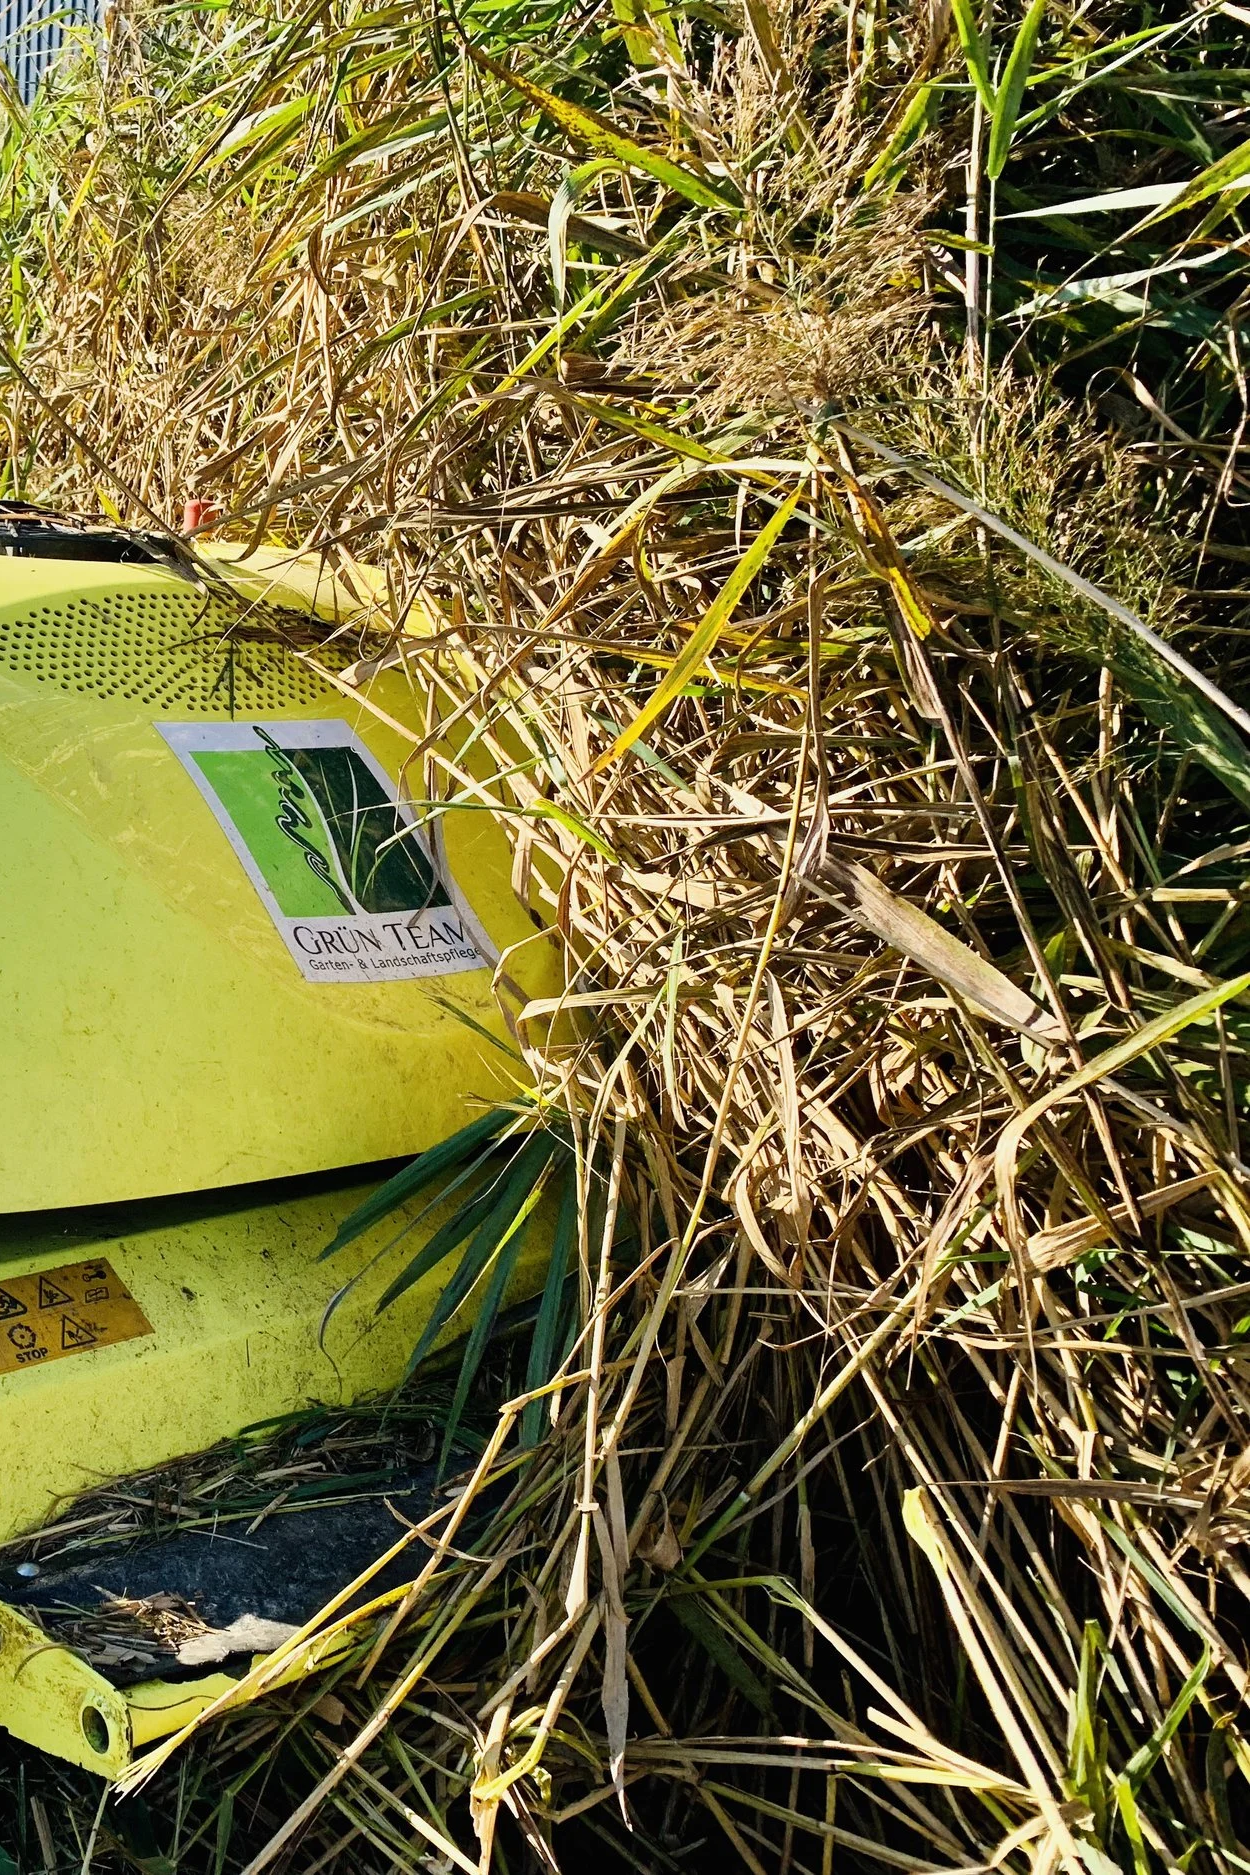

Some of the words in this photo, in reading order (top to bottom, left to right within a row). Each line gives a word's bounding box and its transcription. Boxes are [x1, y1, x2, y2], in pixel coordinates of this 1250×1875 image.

[309, 959, 354, 971] Garten-
[359, 958, 369, 970] &
[16, 1347, 49, 1363] STOP
